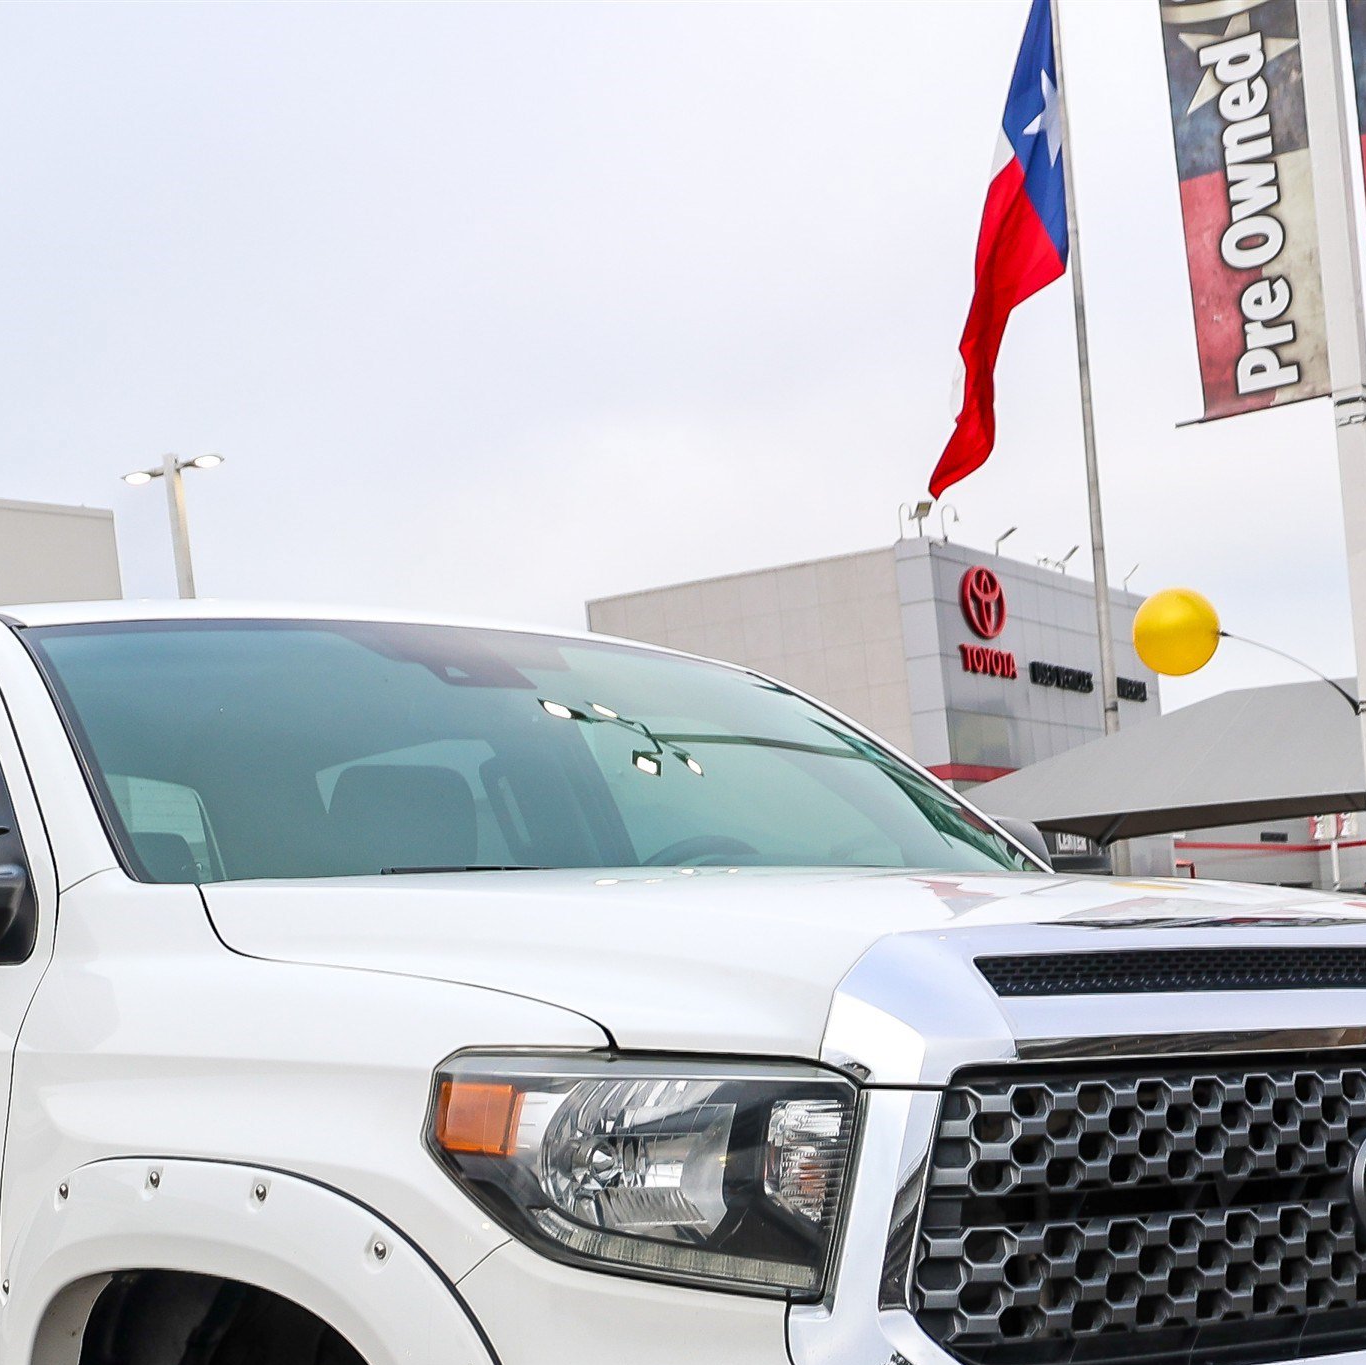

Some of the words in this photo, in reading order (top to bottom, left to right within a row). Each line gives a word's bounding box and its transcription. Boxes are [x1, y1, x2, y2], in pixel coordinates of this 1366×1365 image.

[1199, 31, 1286, 270] Owned
[1237, 276, 1300, 395] Pre
[958, 643, 1018, 680] TOYOTA
